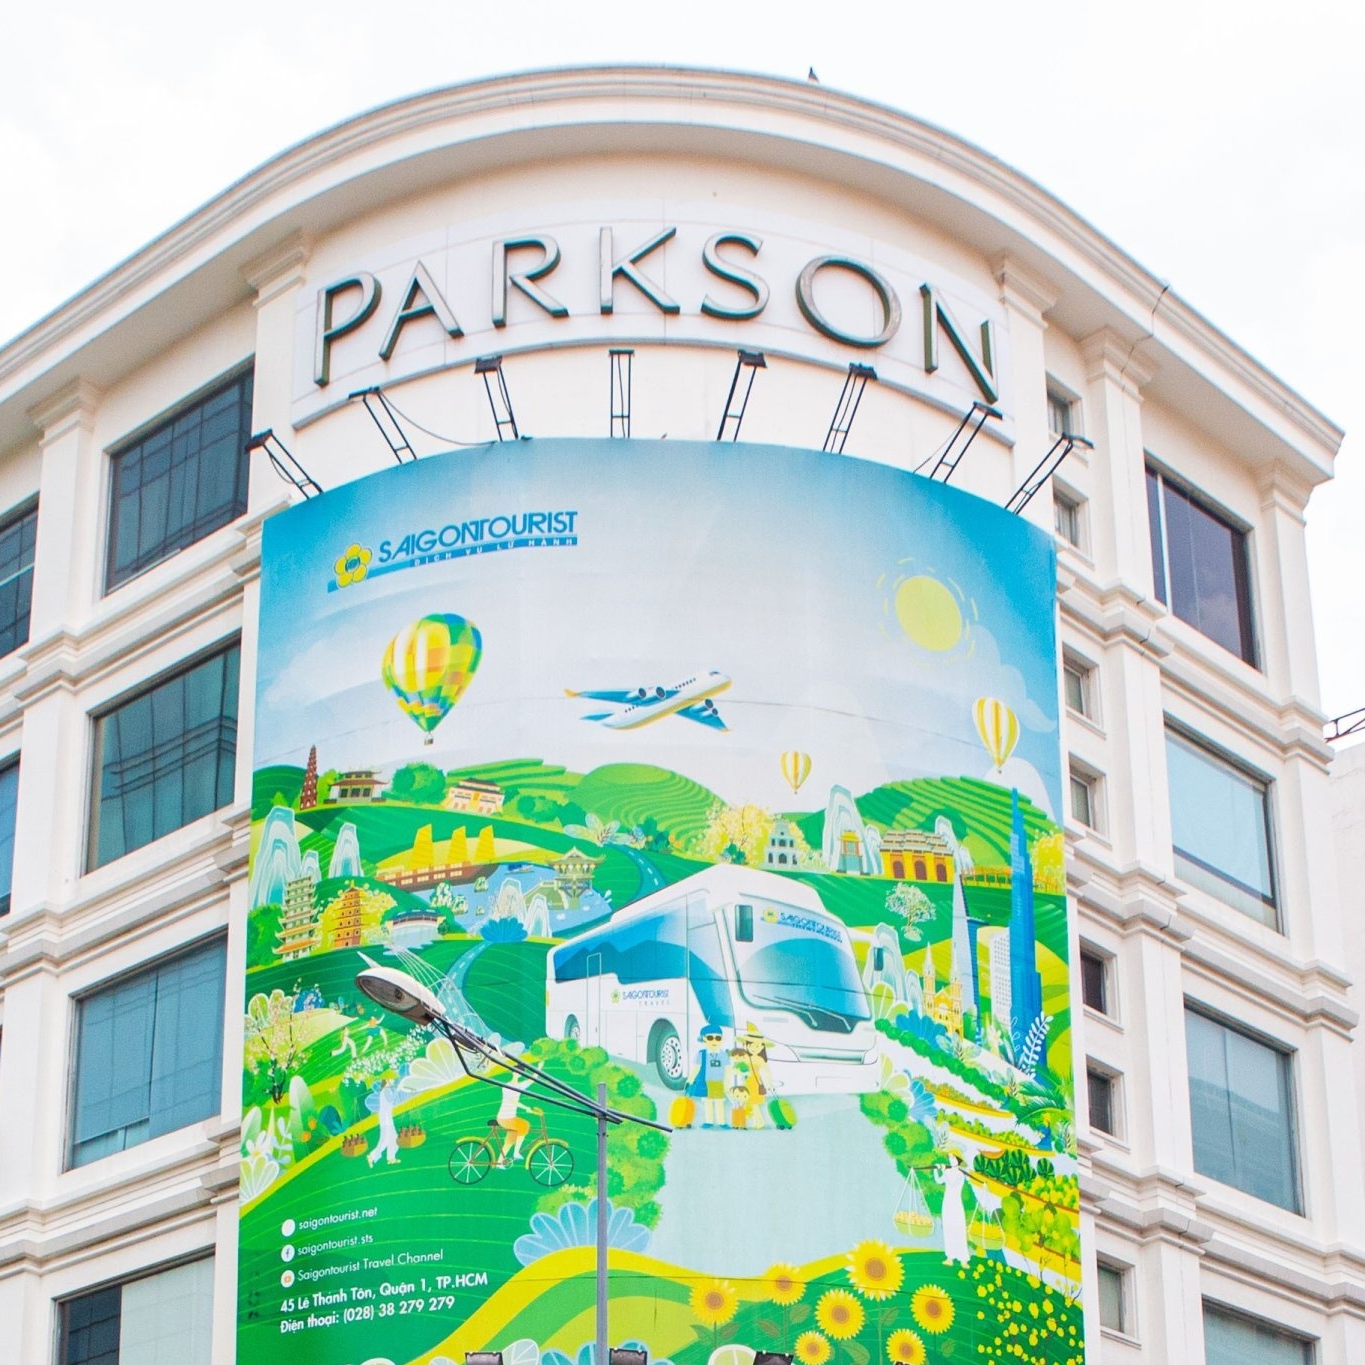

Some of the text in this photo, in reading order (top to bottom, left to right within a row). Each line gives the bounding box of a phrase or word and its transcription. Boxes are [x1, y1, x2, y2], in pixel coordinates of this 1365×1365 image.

[312, 225, 998, 404] PARKSON
[378, 511, 578, 563] SAIGONTOURIST
[298, 1207, 378, 1231] saigontourist.net
[297, 1234, 374, 1257] saigontourist.sts
[298, 1249, 444, 1282] Saigontourist Travel Channel
[280, 1299, 295, 1314] 45
[297, 1297, 310, 1311] Lê
[350, 1286, 376, 1301] Tôn,
[379, 1281, 415, 1298] Quận
[420, 1278, 432, 1294] 1,
[436, 1271, 489, 1291] TP.HCM
[280, 1295, 456, 1334] Điện thoại: (028) 38 279 279
